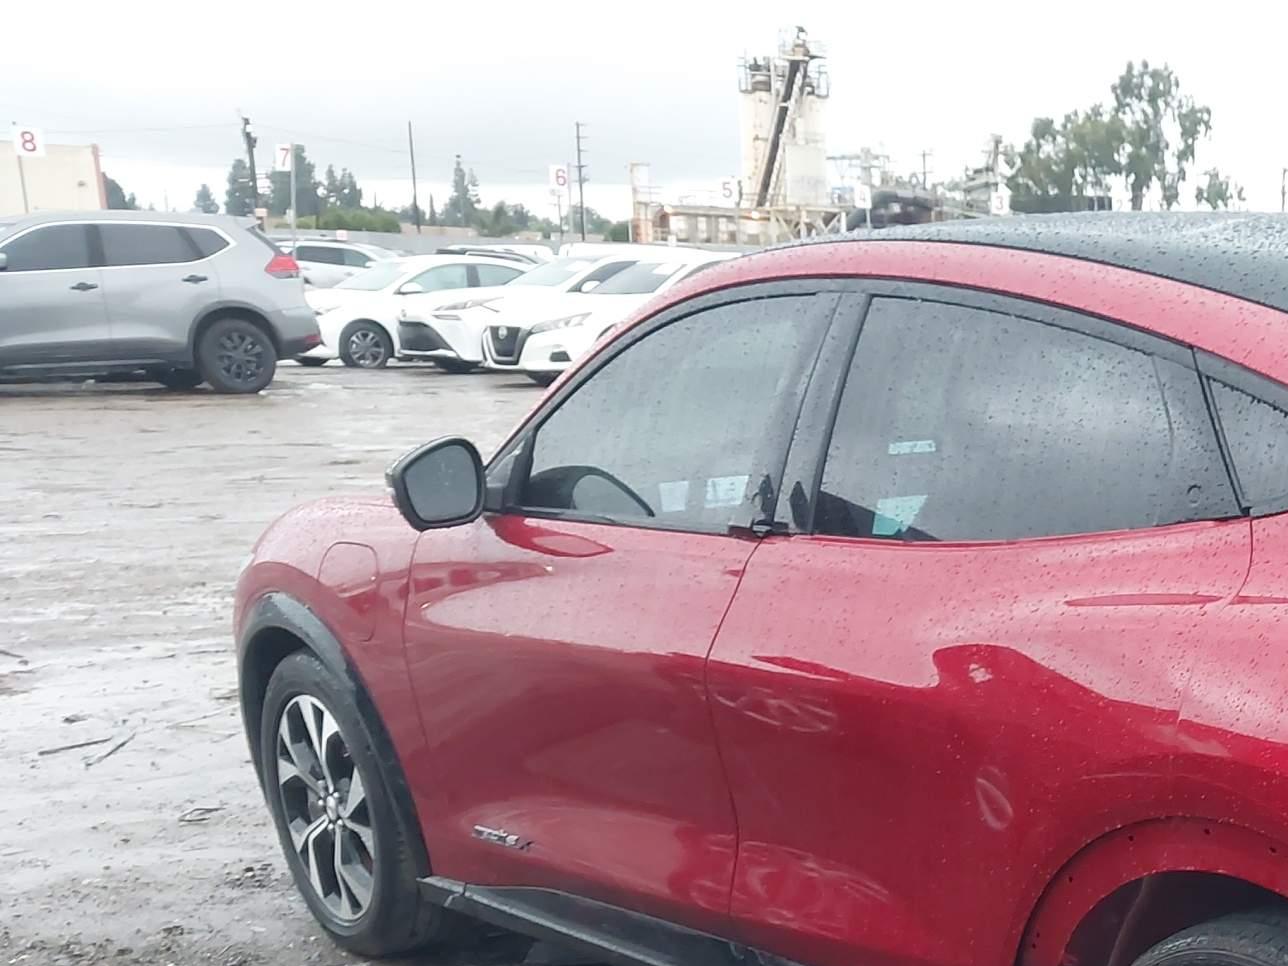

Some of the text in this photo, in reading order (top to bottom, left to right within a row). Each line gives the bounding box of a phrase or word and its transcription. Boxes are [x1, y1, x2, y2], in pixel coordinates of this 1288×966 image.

[20, 131, 37, 152] 8
[279, 147, 289, 167] 7
[555, 168, 567, 186] 6
[722, 181, 733, 199] 5
[995, 195, 1004, 210] 3
